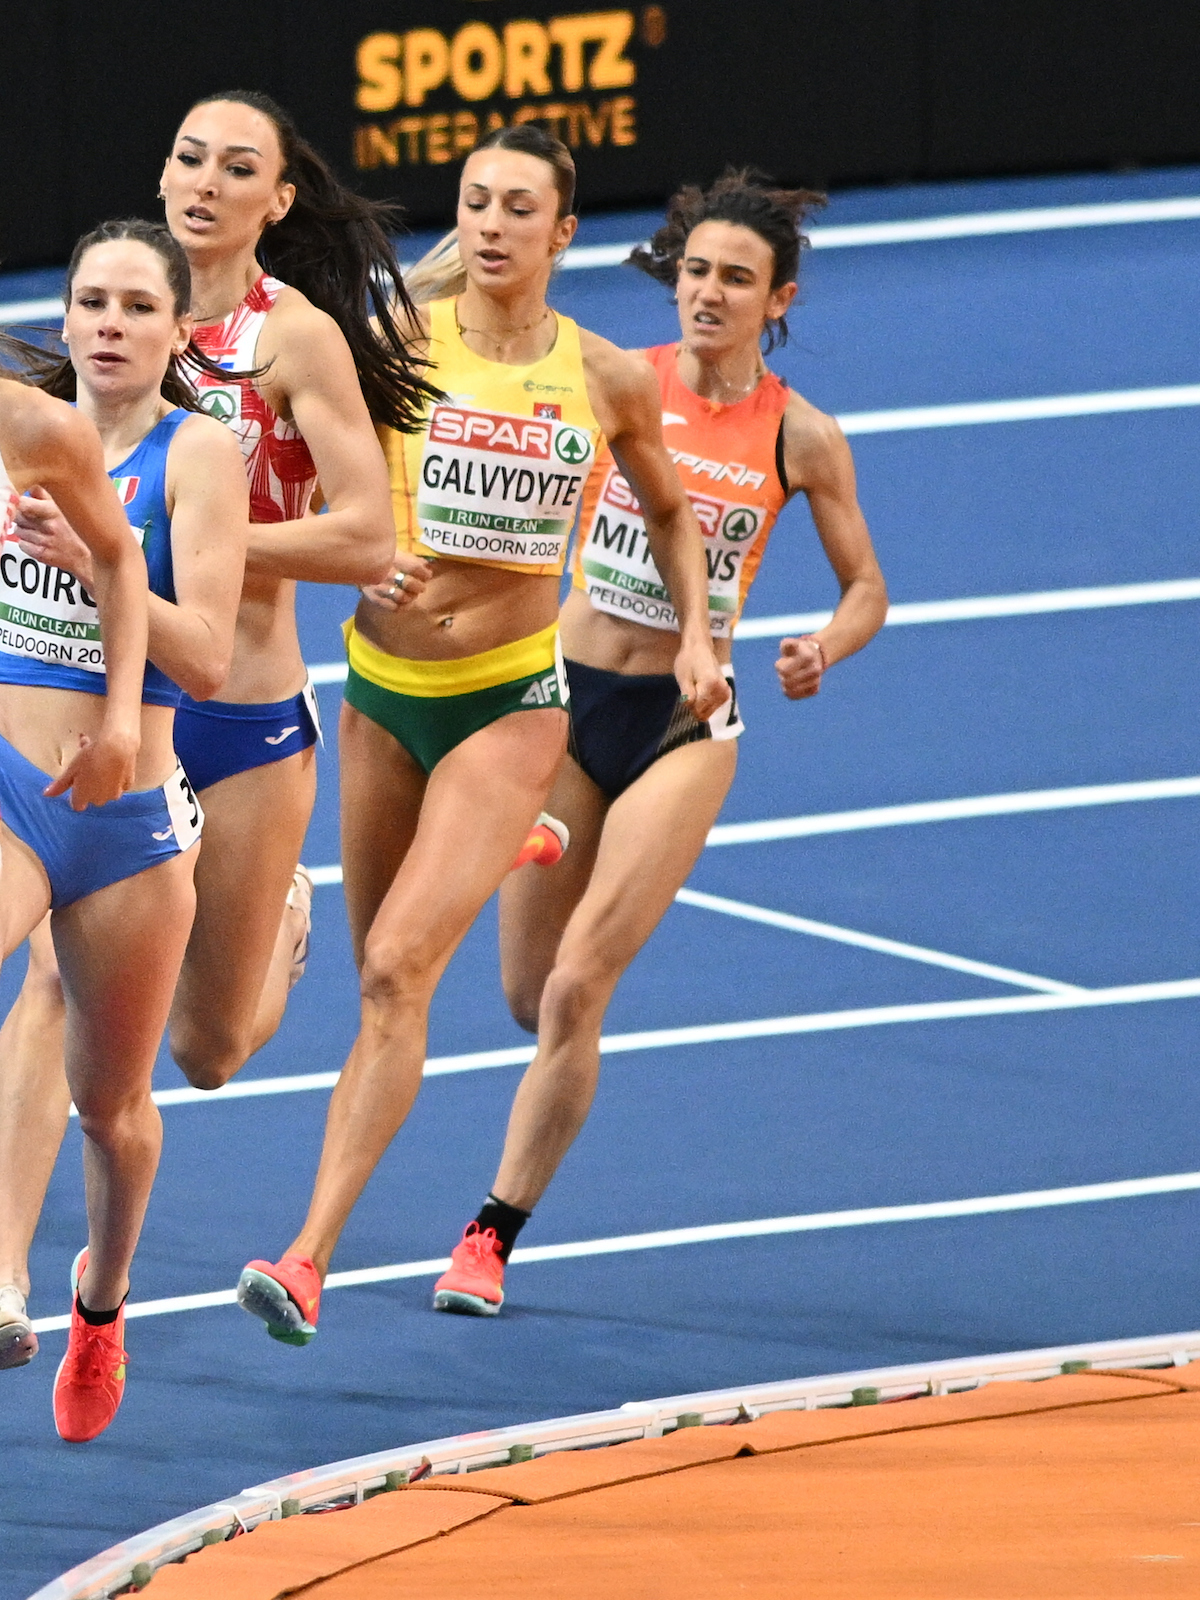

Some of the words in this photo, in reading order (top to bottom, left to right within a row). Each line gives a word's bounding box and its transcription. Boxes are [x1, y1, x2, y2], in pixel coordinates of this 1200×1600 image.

[355, 10, 636, 112] SPORTZ
[433, 411, 549, 455] SPAR
[423, 454, 582, 507] GALVYDYTE
[449, 510, 454, 522] I
[457, 510, 491, 527] RUN
[423, 527, 527, 556] APELDOORN
[530, 542, 561, 557] 2025
[609, 569, 616, 582] I
[617, 572, 649, 594] RUN
[7, 607, 13, 620] I
[12, 609, 38, 628] RUN
[590, 585, 678, 625] PELDOOR
